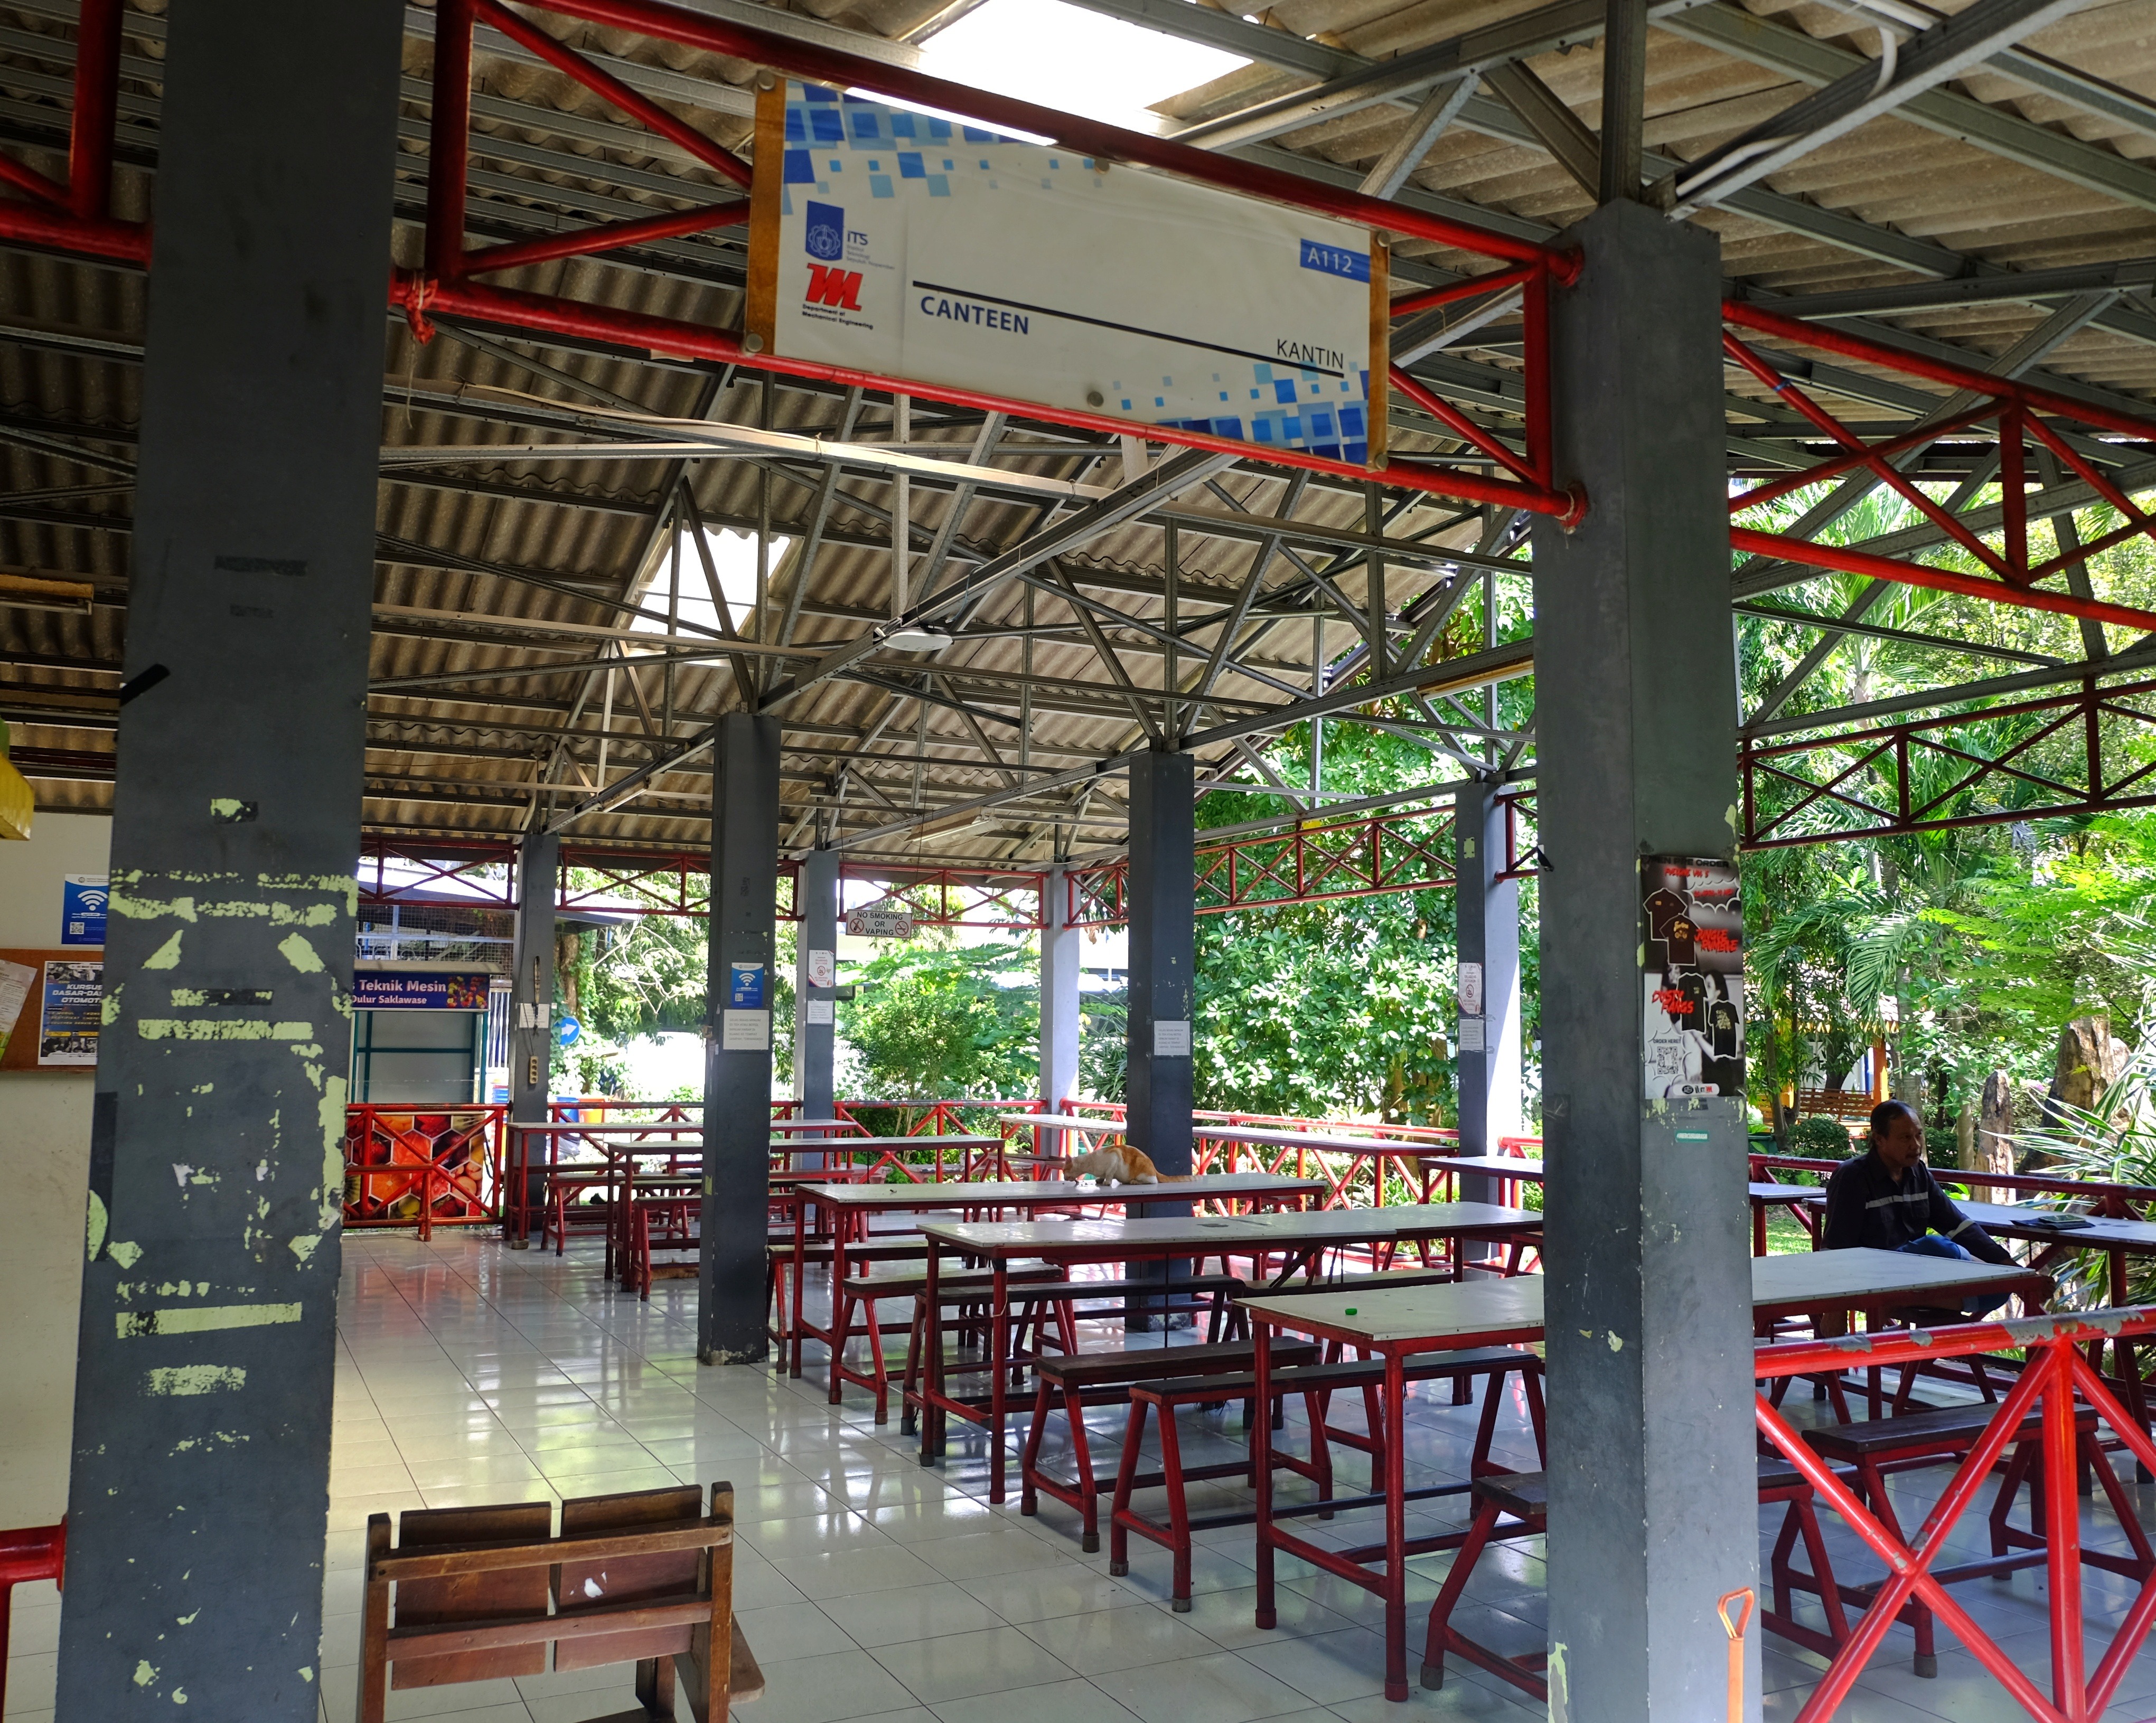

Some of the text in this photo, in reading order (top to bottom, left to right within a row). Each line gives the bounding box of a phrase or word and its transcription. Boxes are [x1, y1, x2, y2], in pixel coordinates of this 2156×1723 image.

[1307, 247, 1353, 274] A112
[802, 304, 838, 316] Department
[921, 296, 1029, 335] CANTEEN
[802, 311, 874, 331] Mechanical Engineering
[1277, 338, 1344, 370] KANTIN
[1695, 859, 1729, 868] ORDER
[870, 912, 903, 920] SMOKING
[1694, 928, 1728, 943] JUNGLE
[359, 979, 403, 992] Teknik
[406, 980, 447, 992] Mesin
[378, 995, 427, 1004] Saklawase
[1652, 990, 1684, 1003] DUSTY
